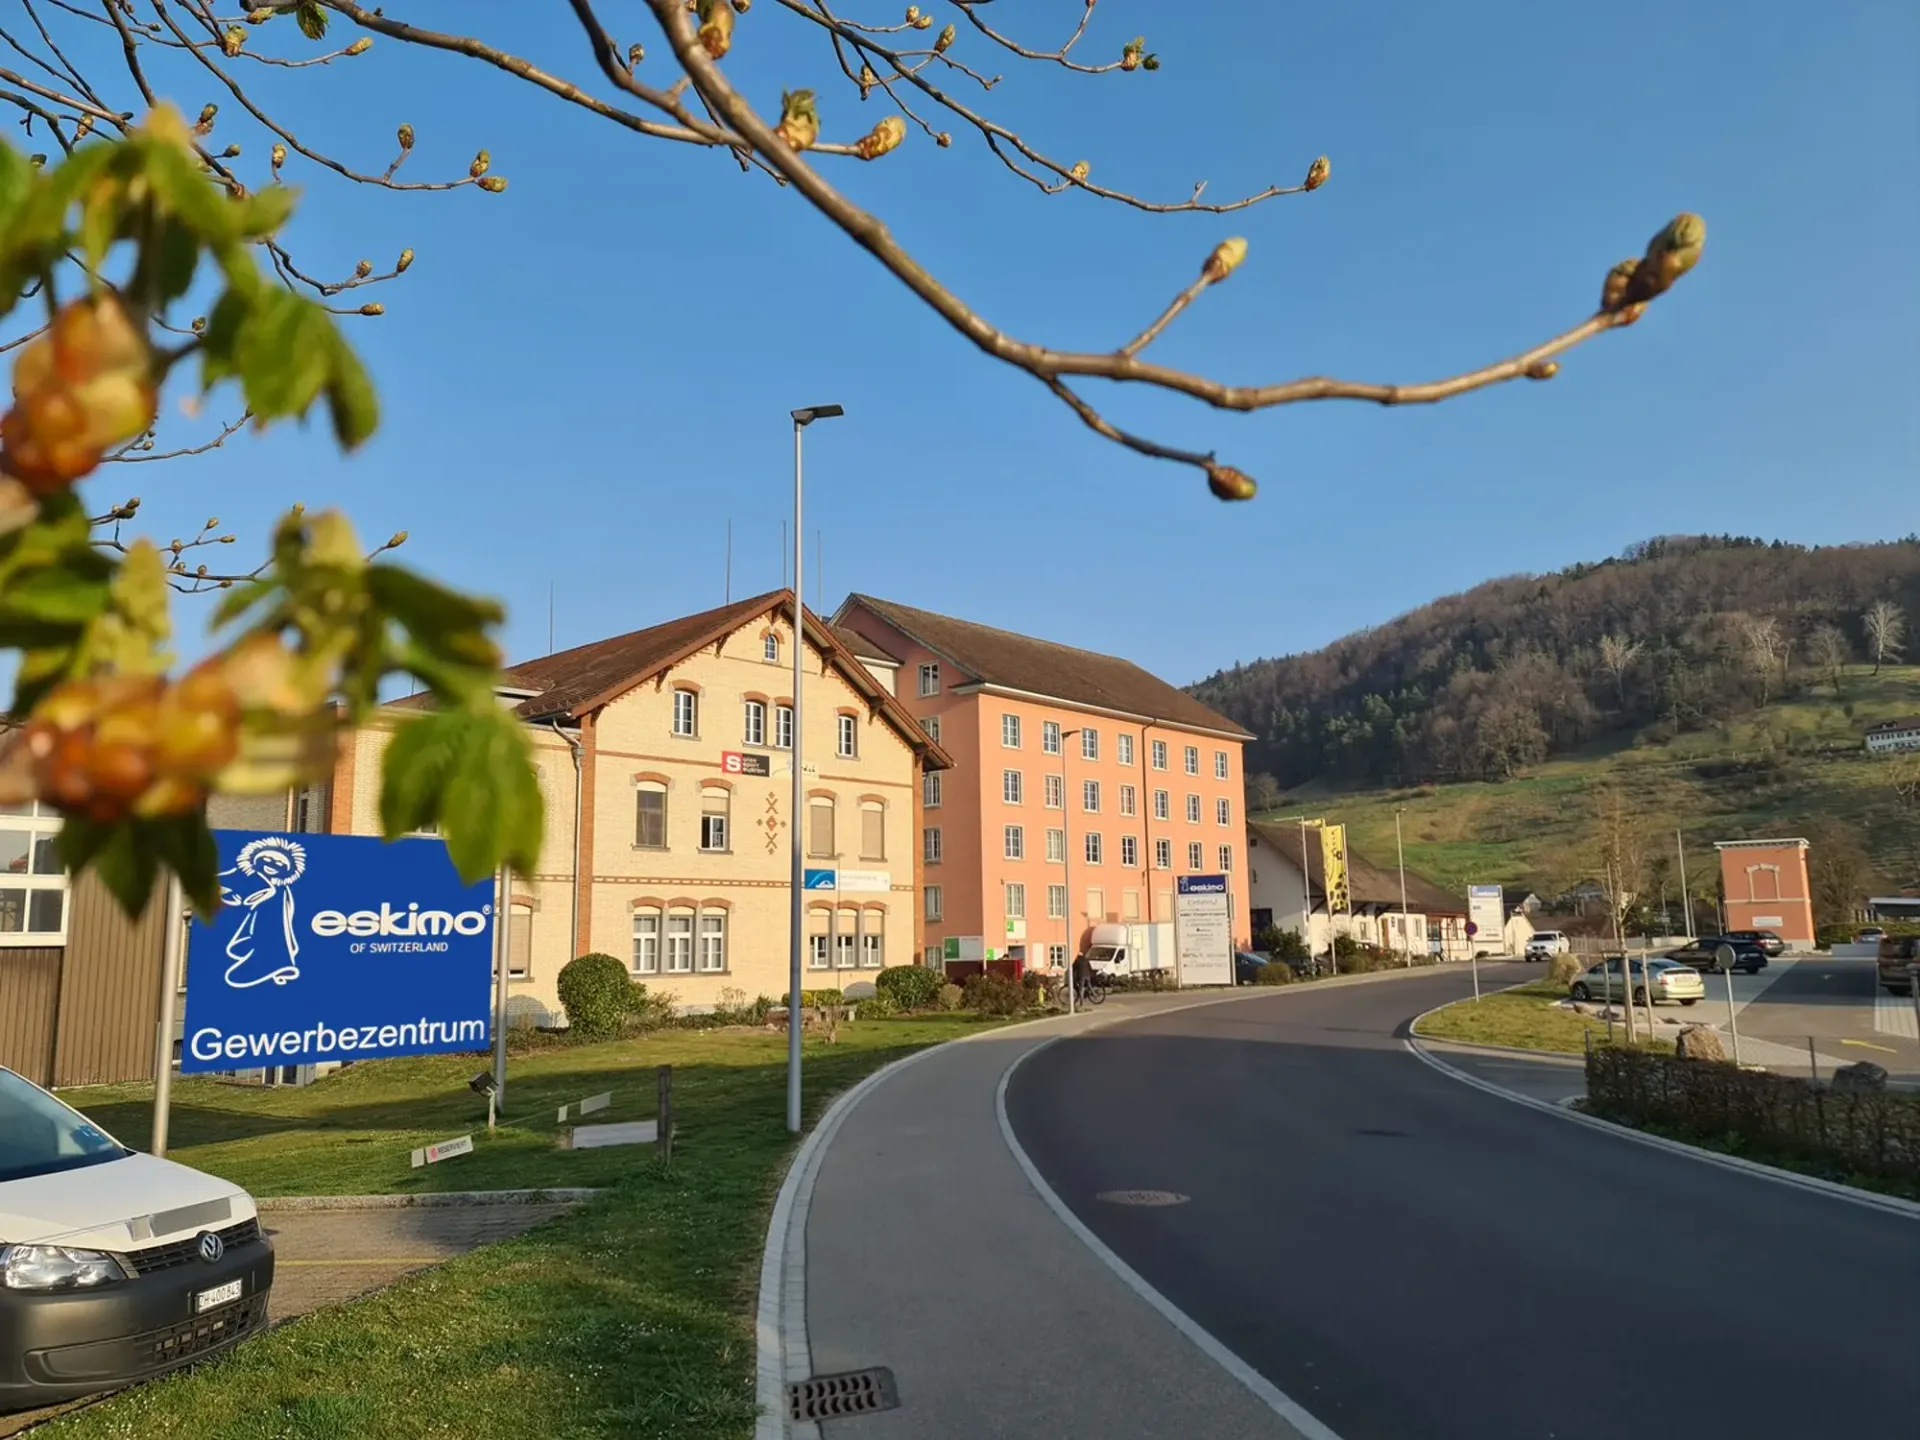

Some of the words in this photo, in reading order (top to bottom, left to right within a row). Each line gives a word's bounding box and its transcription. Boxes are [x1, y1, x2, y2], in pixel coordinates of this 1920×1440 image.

[350, 943, 366, 954] OF
[369, 942, 449, 954] SWITZERLAND
[191, 1017, 485, 1061] Gewerbezentrum
